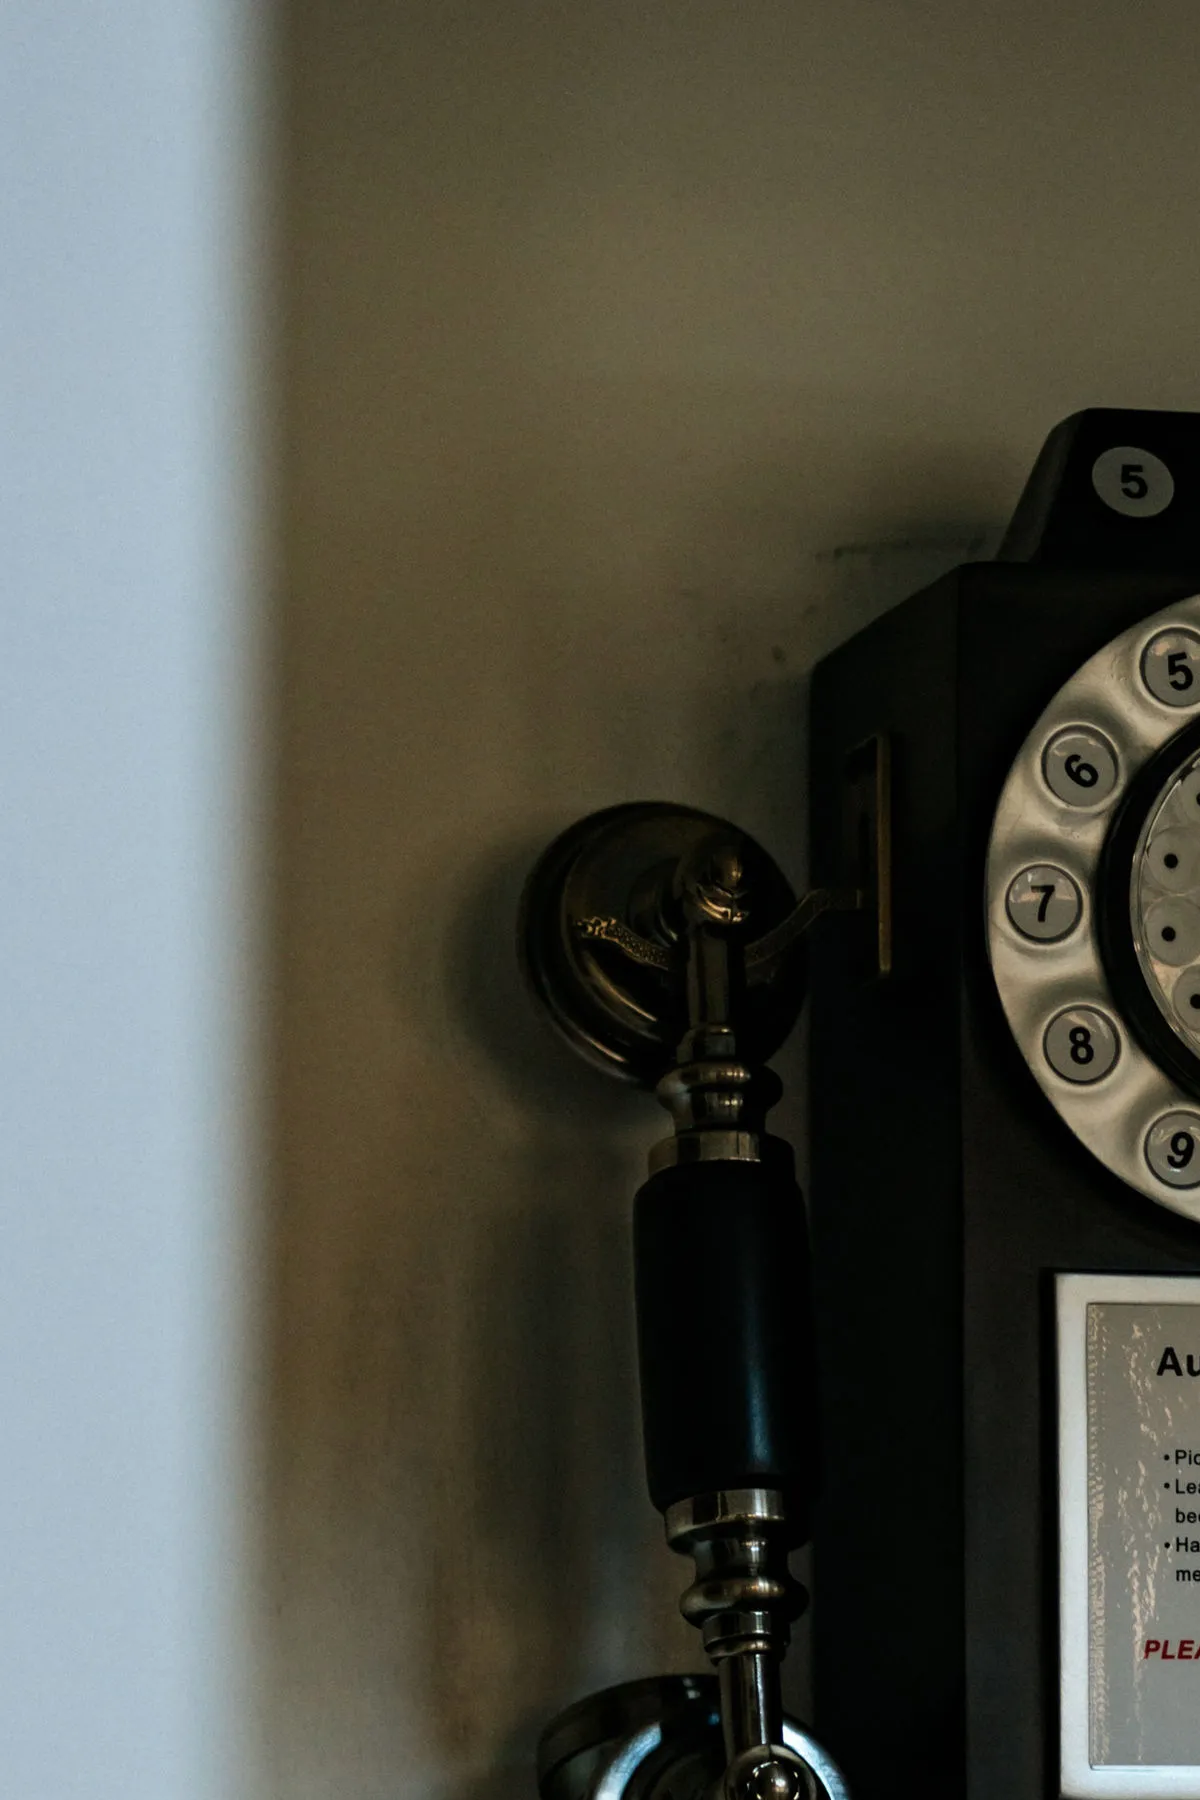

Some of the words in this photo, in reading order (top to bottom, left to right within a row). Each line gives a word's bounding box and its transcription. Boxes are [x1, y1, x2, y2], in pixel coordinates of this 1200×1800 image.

[1119, 463, 1149, 500] 5
[1167, 651, 1195, 690] 5
[1064, 753, 1099, 788] 6
[1029, 885, 1056, 922] 7
[1069, 1026, 1095, 1064] 8
[1166, 1131, 1194, 1169] 9
